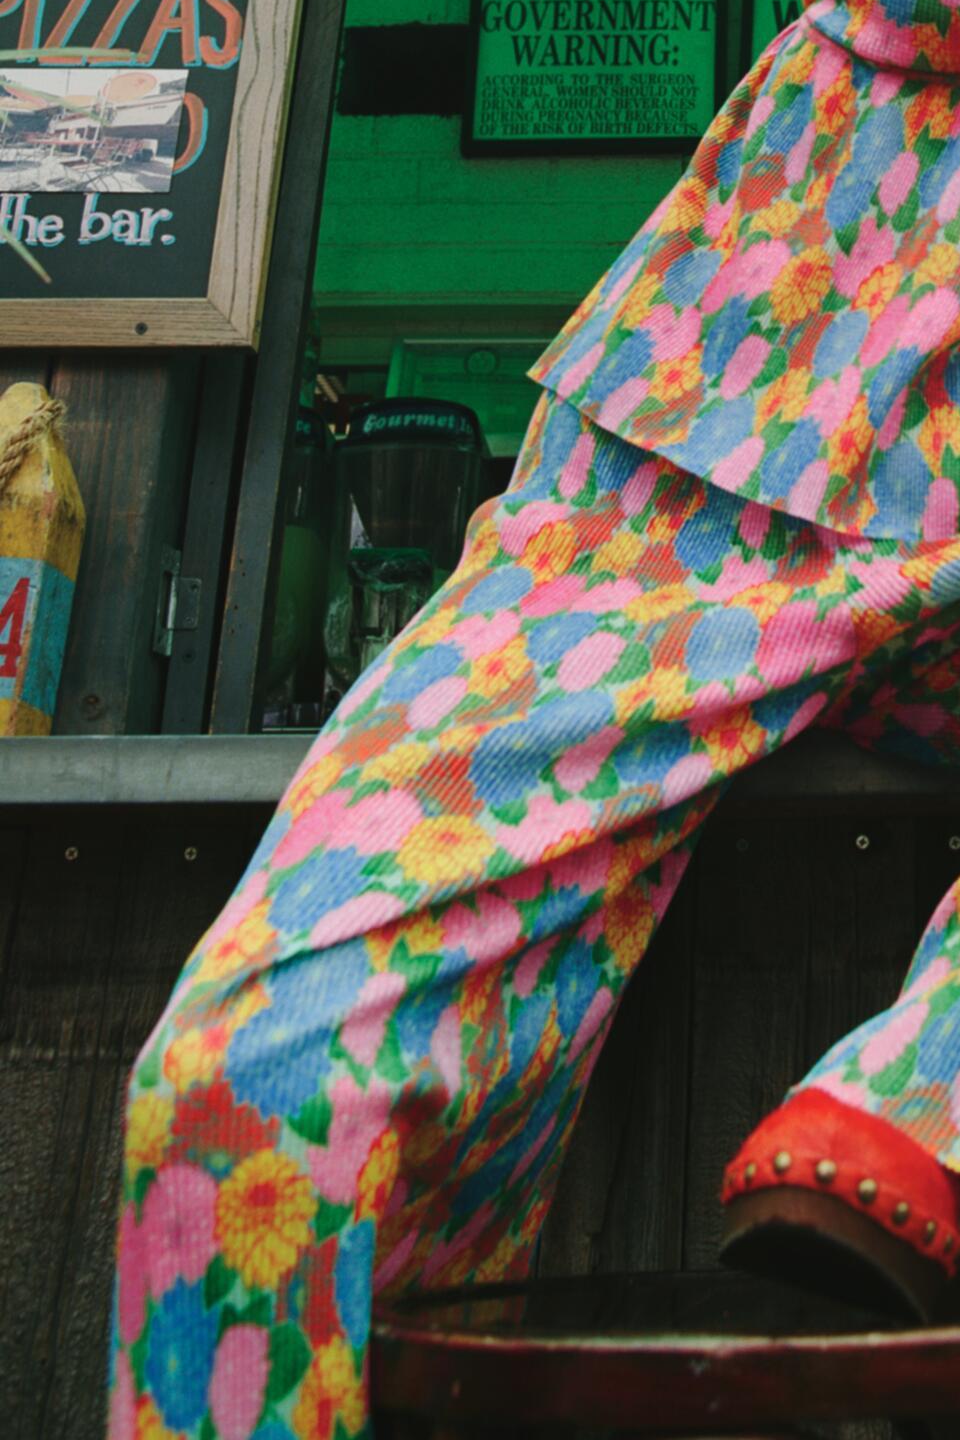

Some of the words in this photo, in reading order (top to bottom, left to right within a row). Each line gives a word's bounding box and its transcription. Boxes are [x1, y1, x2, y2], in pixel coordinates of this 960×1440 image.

[511, 33, 680, 68] WARNING:
[483, 73, 564, 86] ACCORDING
[570, 73, 590, 86] TO
[596, 73, 624, 85] THE
[630, 73, 696, 85] SURGEON
[556, 85, 611, 97] WOMEN
[612, 85, 668, 98] SHOULD
[671, 86, 699, 98] NOT
[482, 98, 524, 110] DRINK
[533, 97, 611, 109] ALCOHOLIC
[615, 97, 697, 109] BEVERAGES
[480, 111, 533, 123] DURING
[538, 110, 621, 122] PREGNANCY
[625, 110, 688, 122] BECAUSE
[479, 123, 498, 136] OF
[502, 123, 529, 135] THE
[532, 122, 564, 134] RISK
[568, 122, 586, 134] OF
[590, 122, 632, 134] BIRTH
[0, 192, 65, 247] the
[78, 192, 176, 246] bar.
